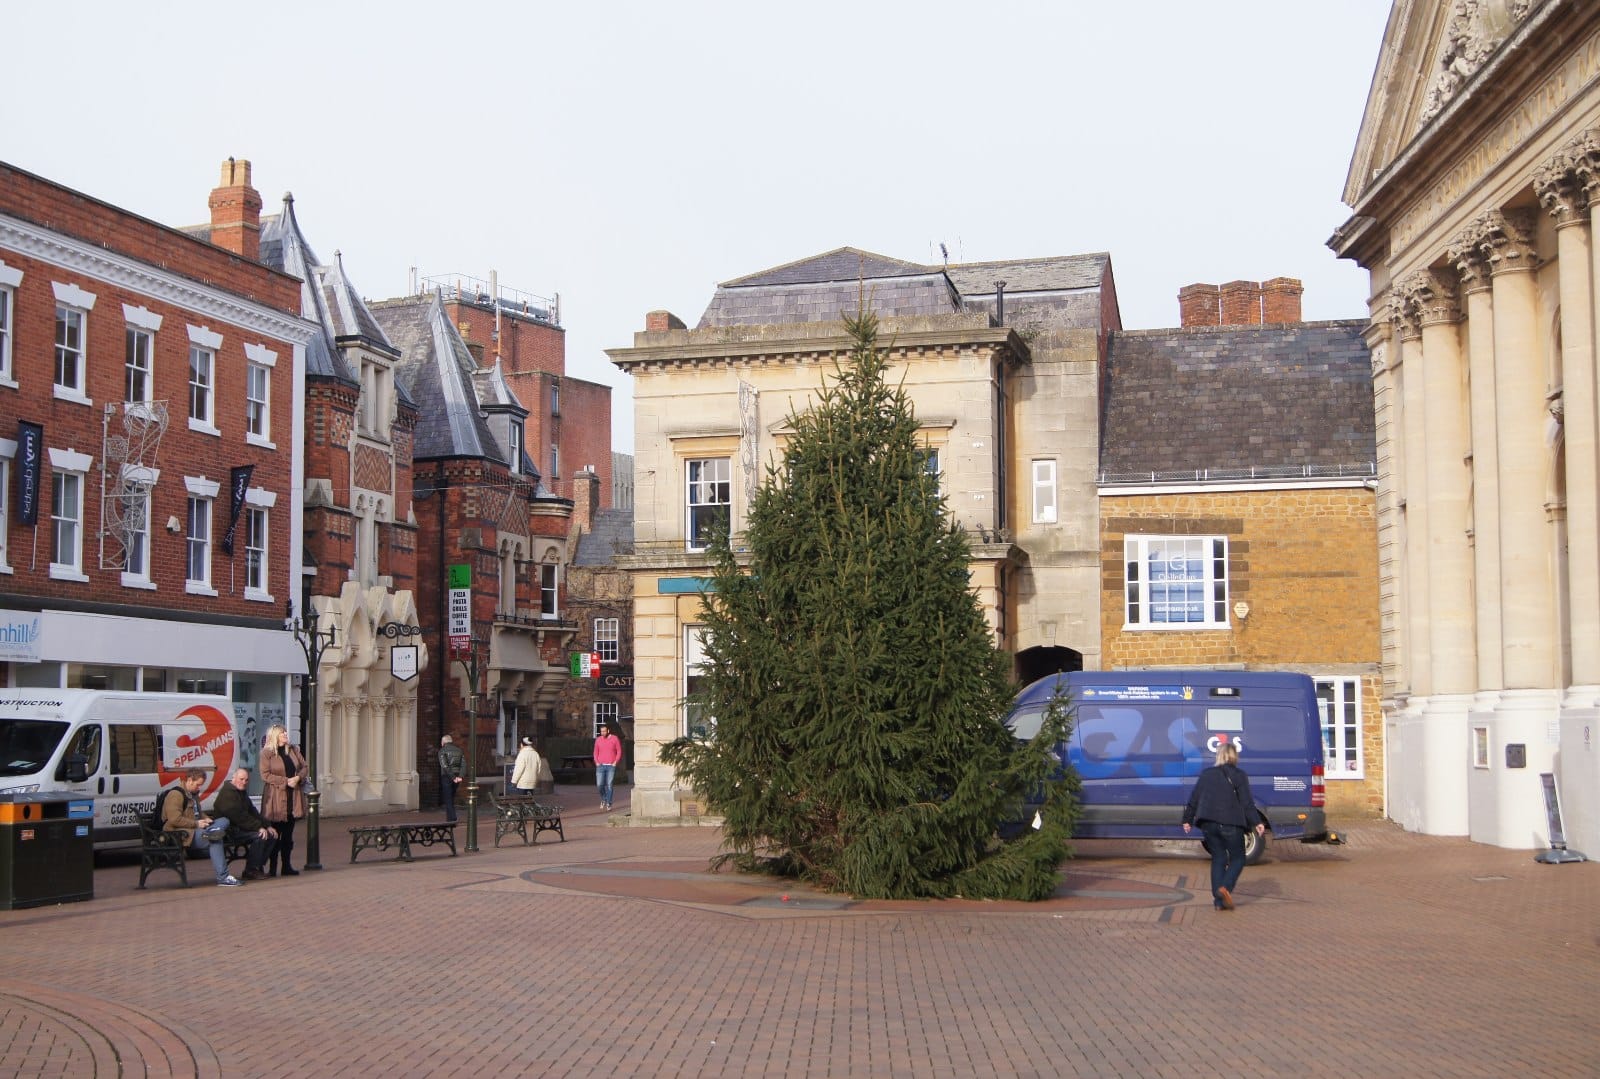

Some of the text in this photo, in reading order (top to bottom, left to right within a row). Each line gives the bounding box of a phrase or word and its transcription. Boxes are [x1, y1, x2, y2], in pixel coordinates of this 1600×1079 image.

[1502, 68, 1567, 151] CENTRE
[174, 730, 234, 767] SPEAKMANS
[1207, 733, 1243, 753] GS
